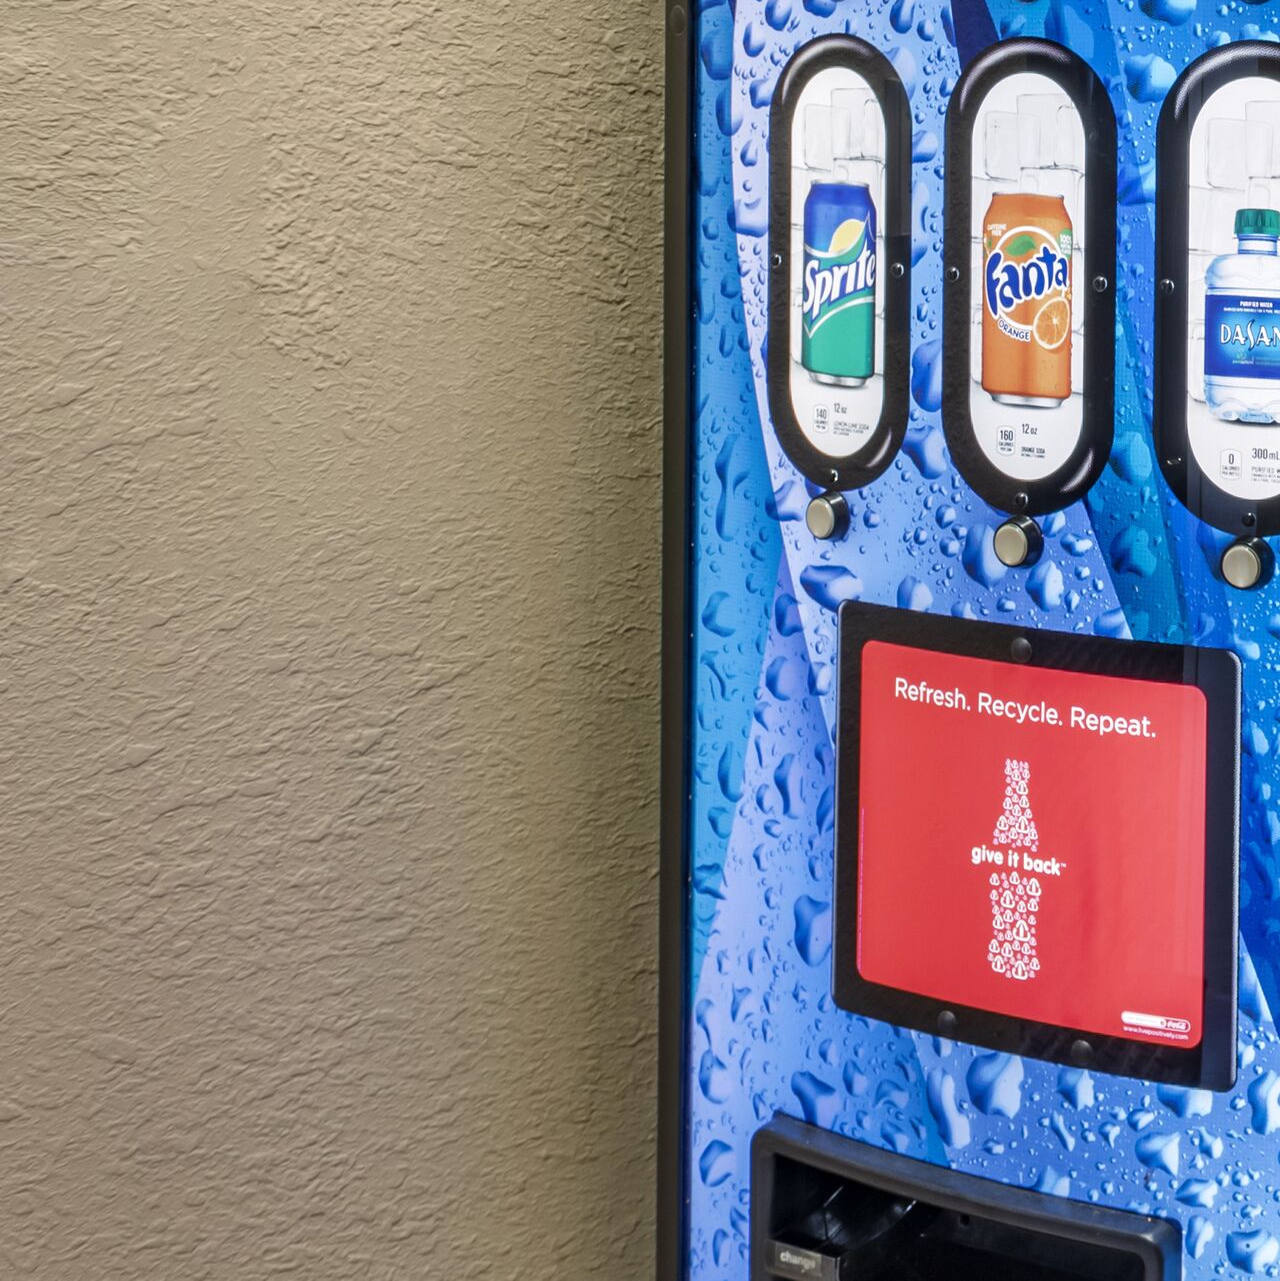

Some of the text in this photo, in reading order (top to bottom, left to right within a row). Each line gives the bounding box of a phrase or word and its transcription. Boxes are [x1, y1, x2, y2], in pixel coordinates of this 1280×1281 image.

[803, 238, 876, 320] Sprite
[894, 676, 1157, 739] Refresh. Recycle. Repeat.
[971, 844, 1061, 877] give it back
[780, 1250, 816, 1270] change
